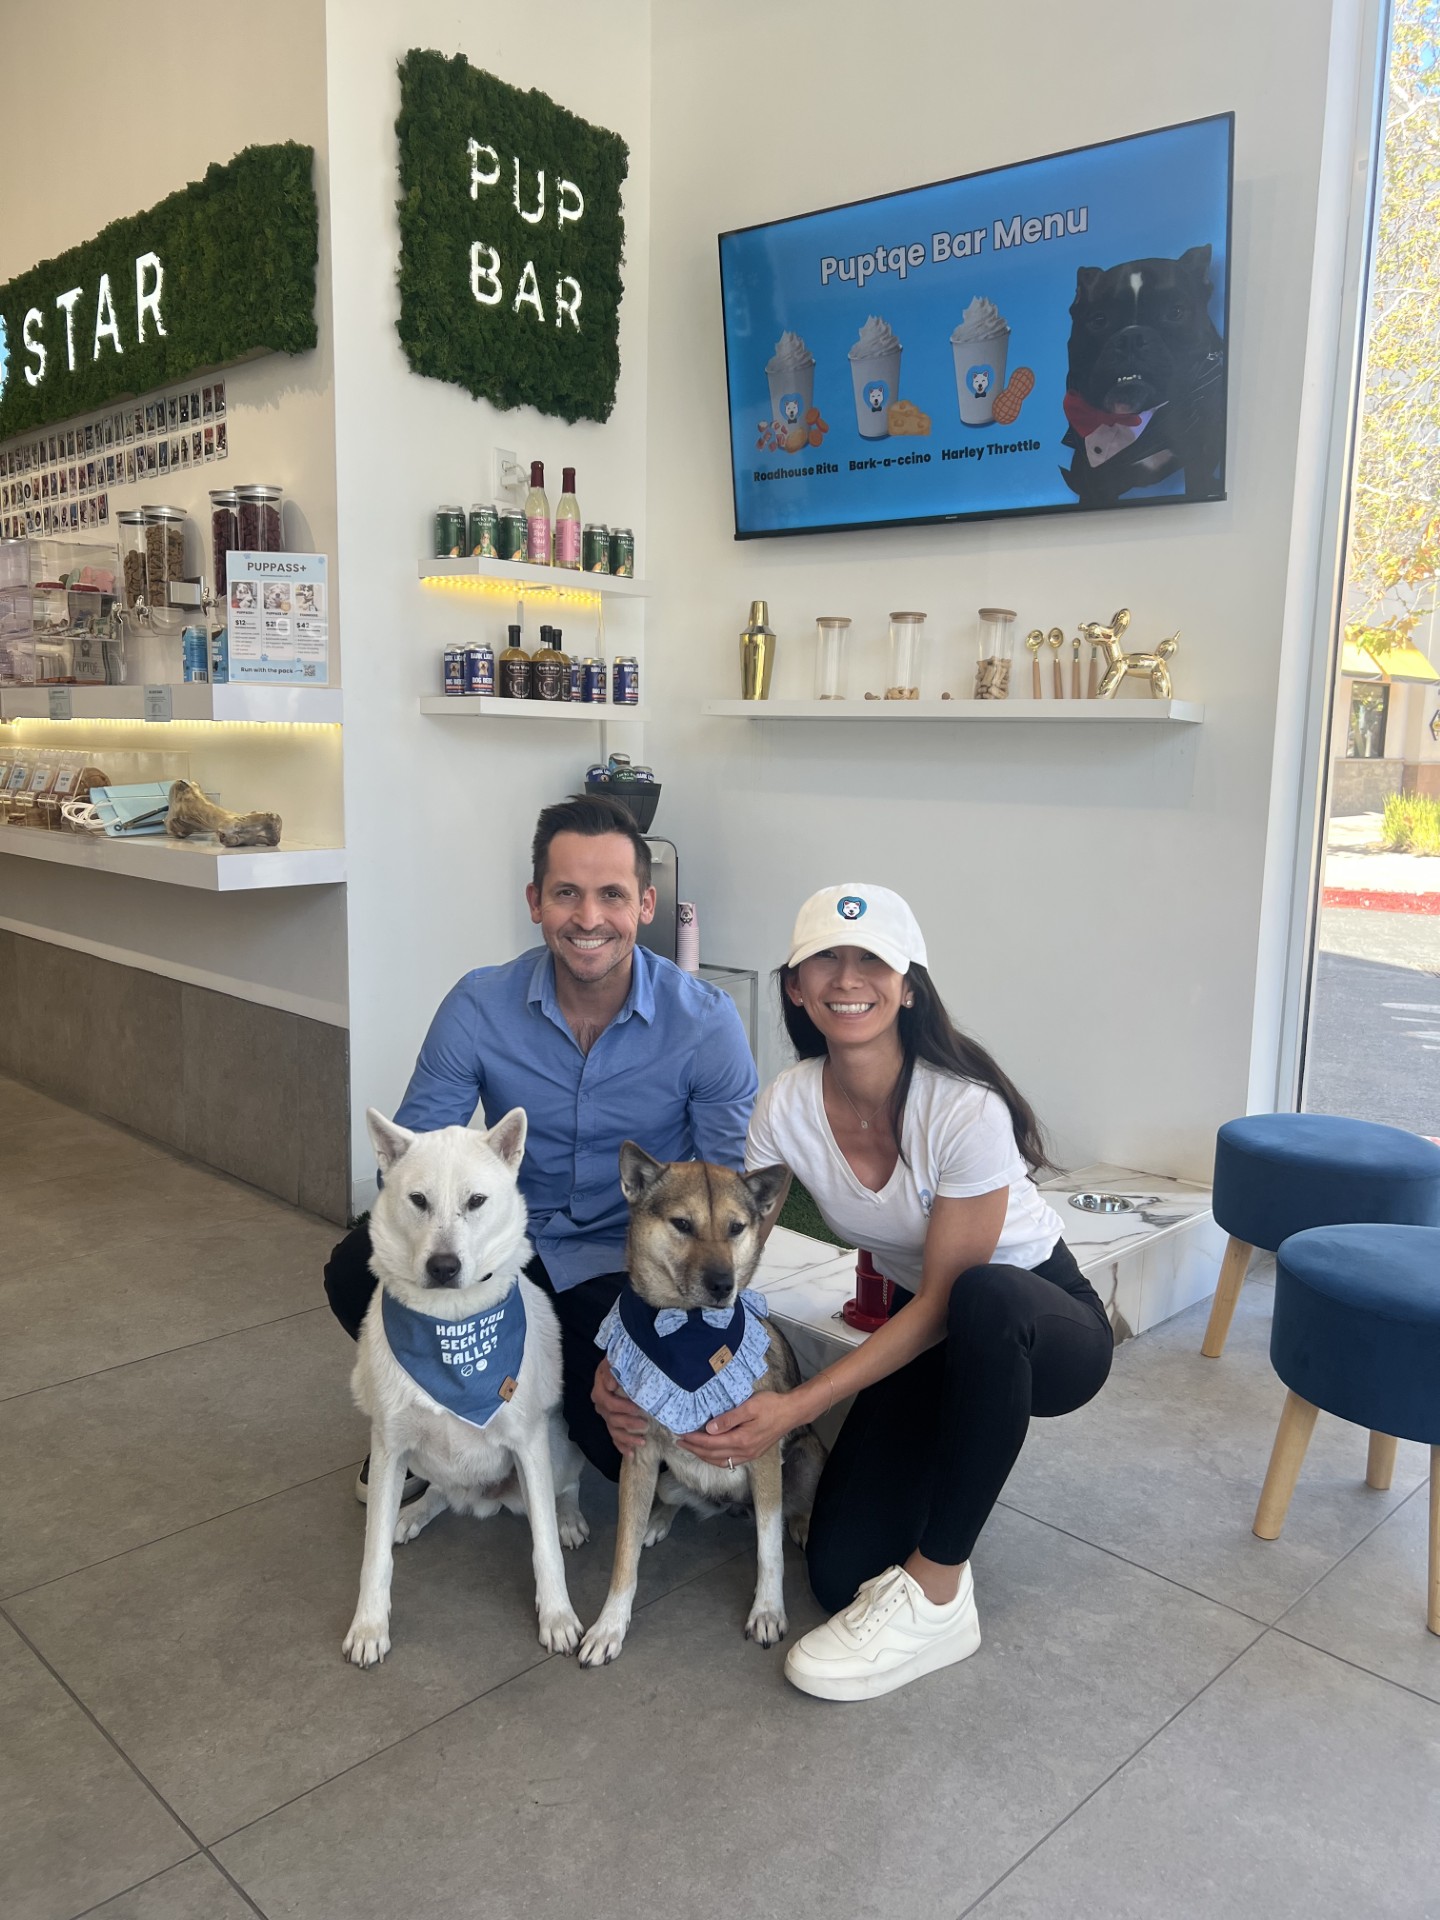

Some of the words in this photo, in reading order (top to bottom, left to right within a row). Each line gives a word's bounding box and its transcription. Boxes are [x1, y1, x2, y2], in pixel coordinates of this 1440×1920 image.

[467, 137, 584, 231] PUP
[820, 243, 926, 288] Puptqe
[932, 228, 987, 263] Bar
[993, 206, 1088, 250] Menu
[469, 241, 583, 333] BAR
[23, 252, 168, 387] STAR
[849, 452, 932, 471] Bark-a-ccino
[941, 446, 985, 462] Harley
[986, 439, 1041, 456] Throttle
[753, 467, 814, 482] Roadhouse
[816, 462, 839, 475] Rita
[247, 562, 307, 573] PUPPASS+
[436, 1322, 476, 1336] HAVE
[480, 1309, 504, 1327] YOU
[441, 1333, 476, 1350] SEEN
[480, 1323, 497, 1339] MY
[442, 1335, 497, 1365] BALLS?
